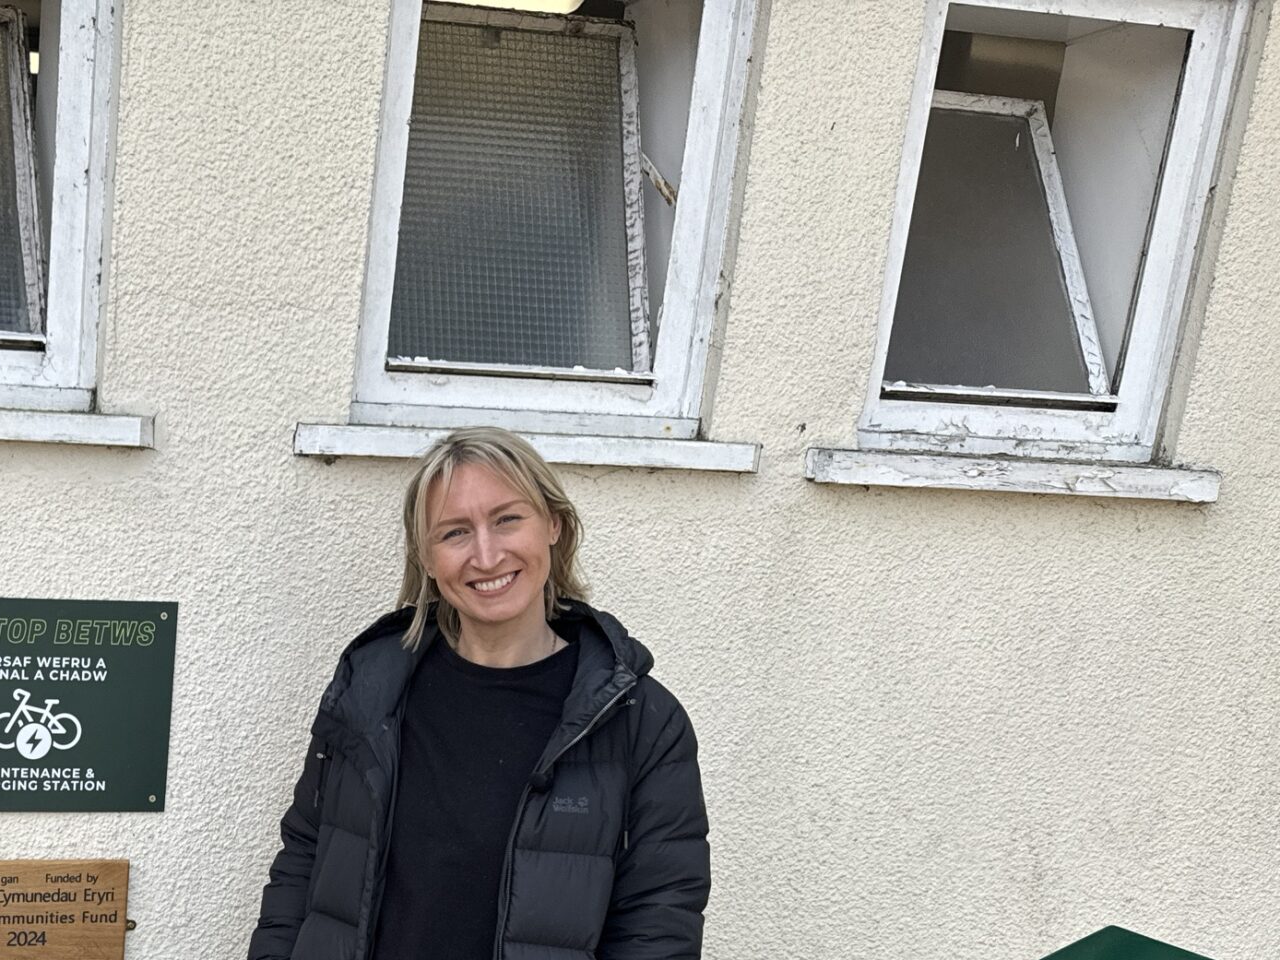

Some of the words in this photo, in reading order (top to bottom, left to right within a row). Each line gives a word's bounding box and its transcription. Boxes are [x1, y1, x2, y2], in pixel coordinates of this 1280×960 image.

[53, 619, 156, 647] BETWS
[37, 656, 91, 669] WEFRU
[95, 657, 107, 669] A
[33, 669, 45, 681] A
[49, 669, 108, 682] CHADW
[85, 768, 95, 779] &
[42, 780, 106, 792] STATION
[0, 876, 19, 886] gan
[45, 873, 82, 883] Funded
[86, 873, 99, 885] by
[83, 887, 115, 906] Eryri
[82, 910, 118, 924] Fund
[6, 931, 47, 947] 2024
